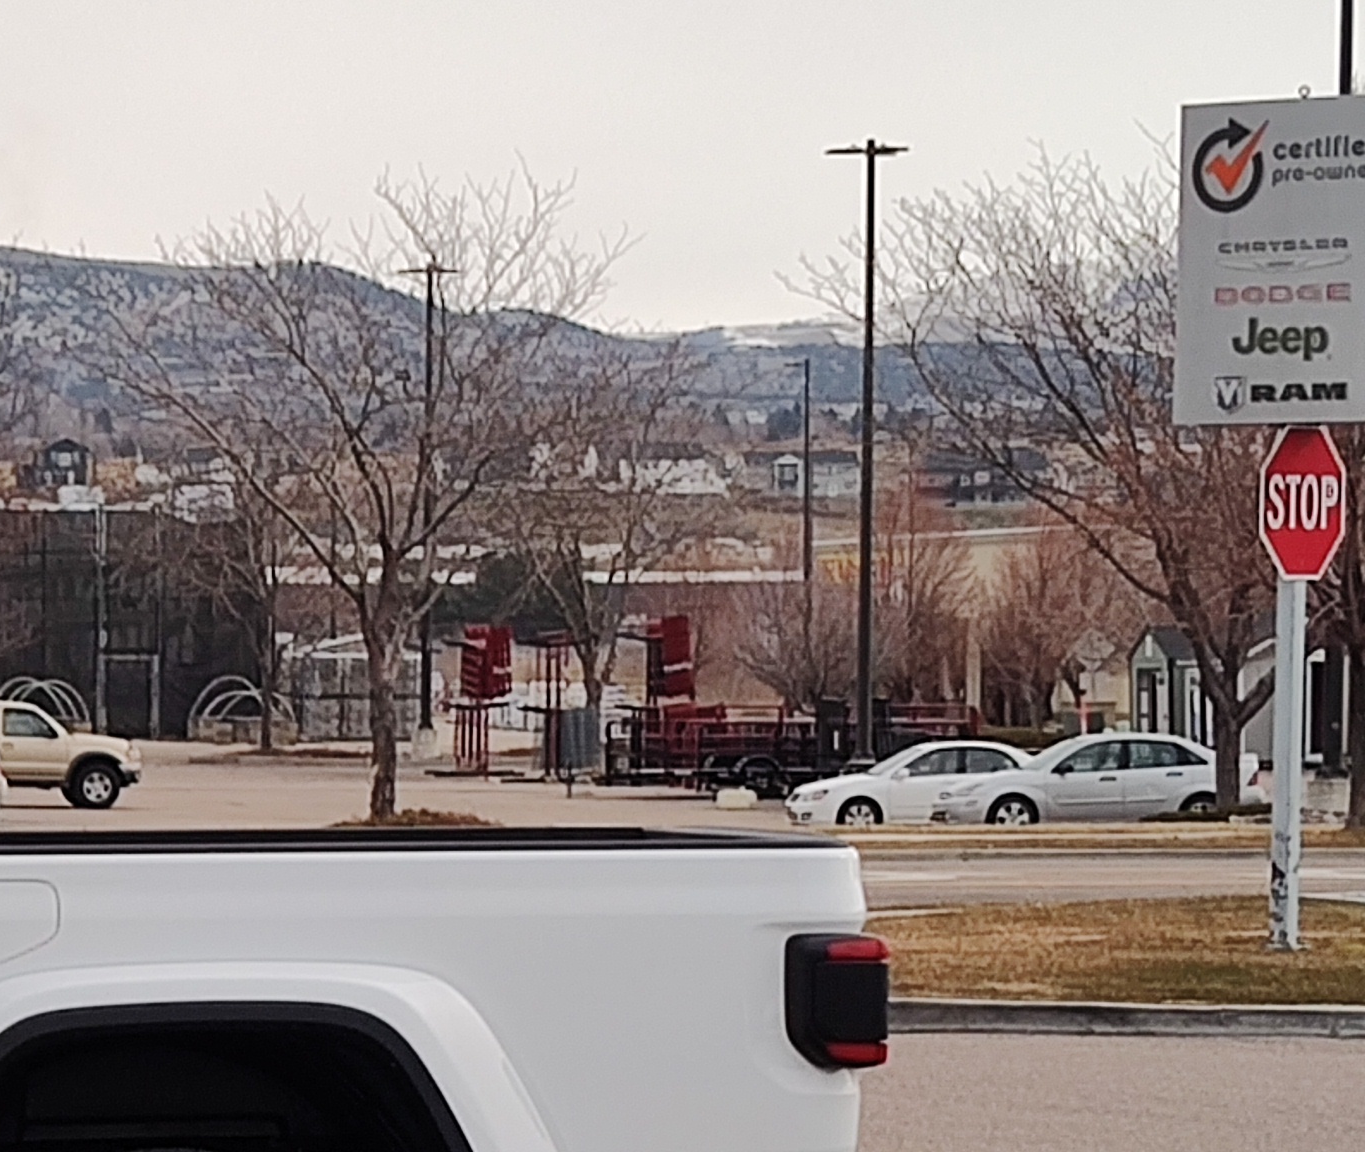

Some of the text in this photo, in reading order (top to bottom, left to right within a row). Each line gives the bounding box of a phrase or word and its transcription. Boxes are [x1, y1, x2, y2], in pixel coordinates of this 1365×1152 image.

[1218, 237, 1348, 254] CHRYSLER
[1215, 282, 1351, 306] DODGE
[1232, 317, 1329, 361] Jeep
[1250, 382, 1348, 403] RAM
[1267, 473, 1339, 531] STOP
